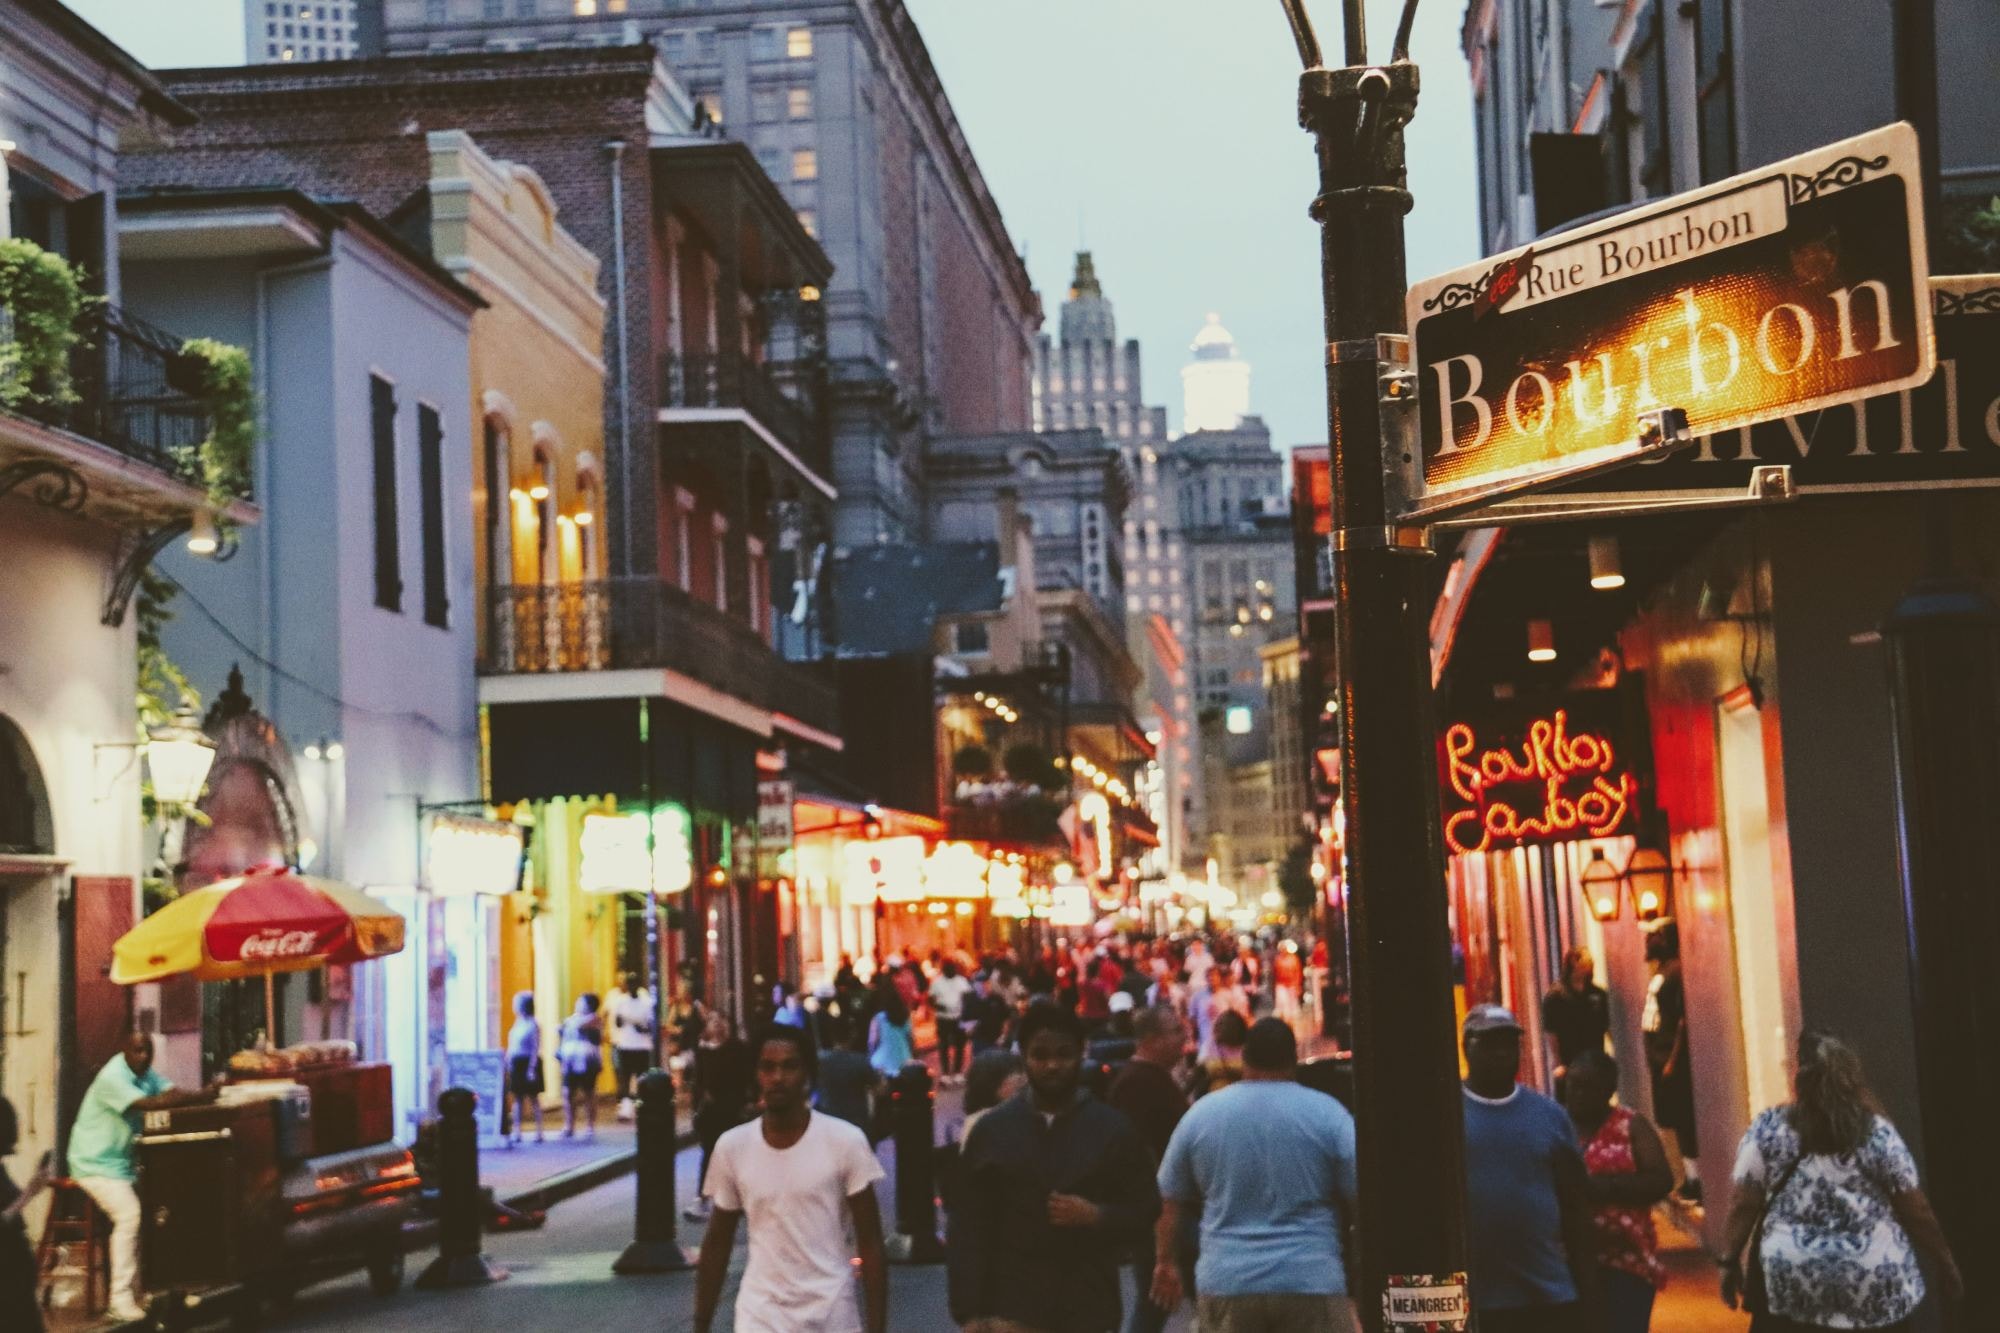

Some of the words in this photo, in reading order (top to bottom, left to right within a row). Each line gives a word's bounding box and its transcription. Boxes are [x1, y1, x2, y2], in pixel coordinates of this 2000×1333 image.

[1525, 263, 1585, 299] Rue
[1598, 210, 1755, 278] Bourbon
[1428, 279, 1902, 459] Bourbon
